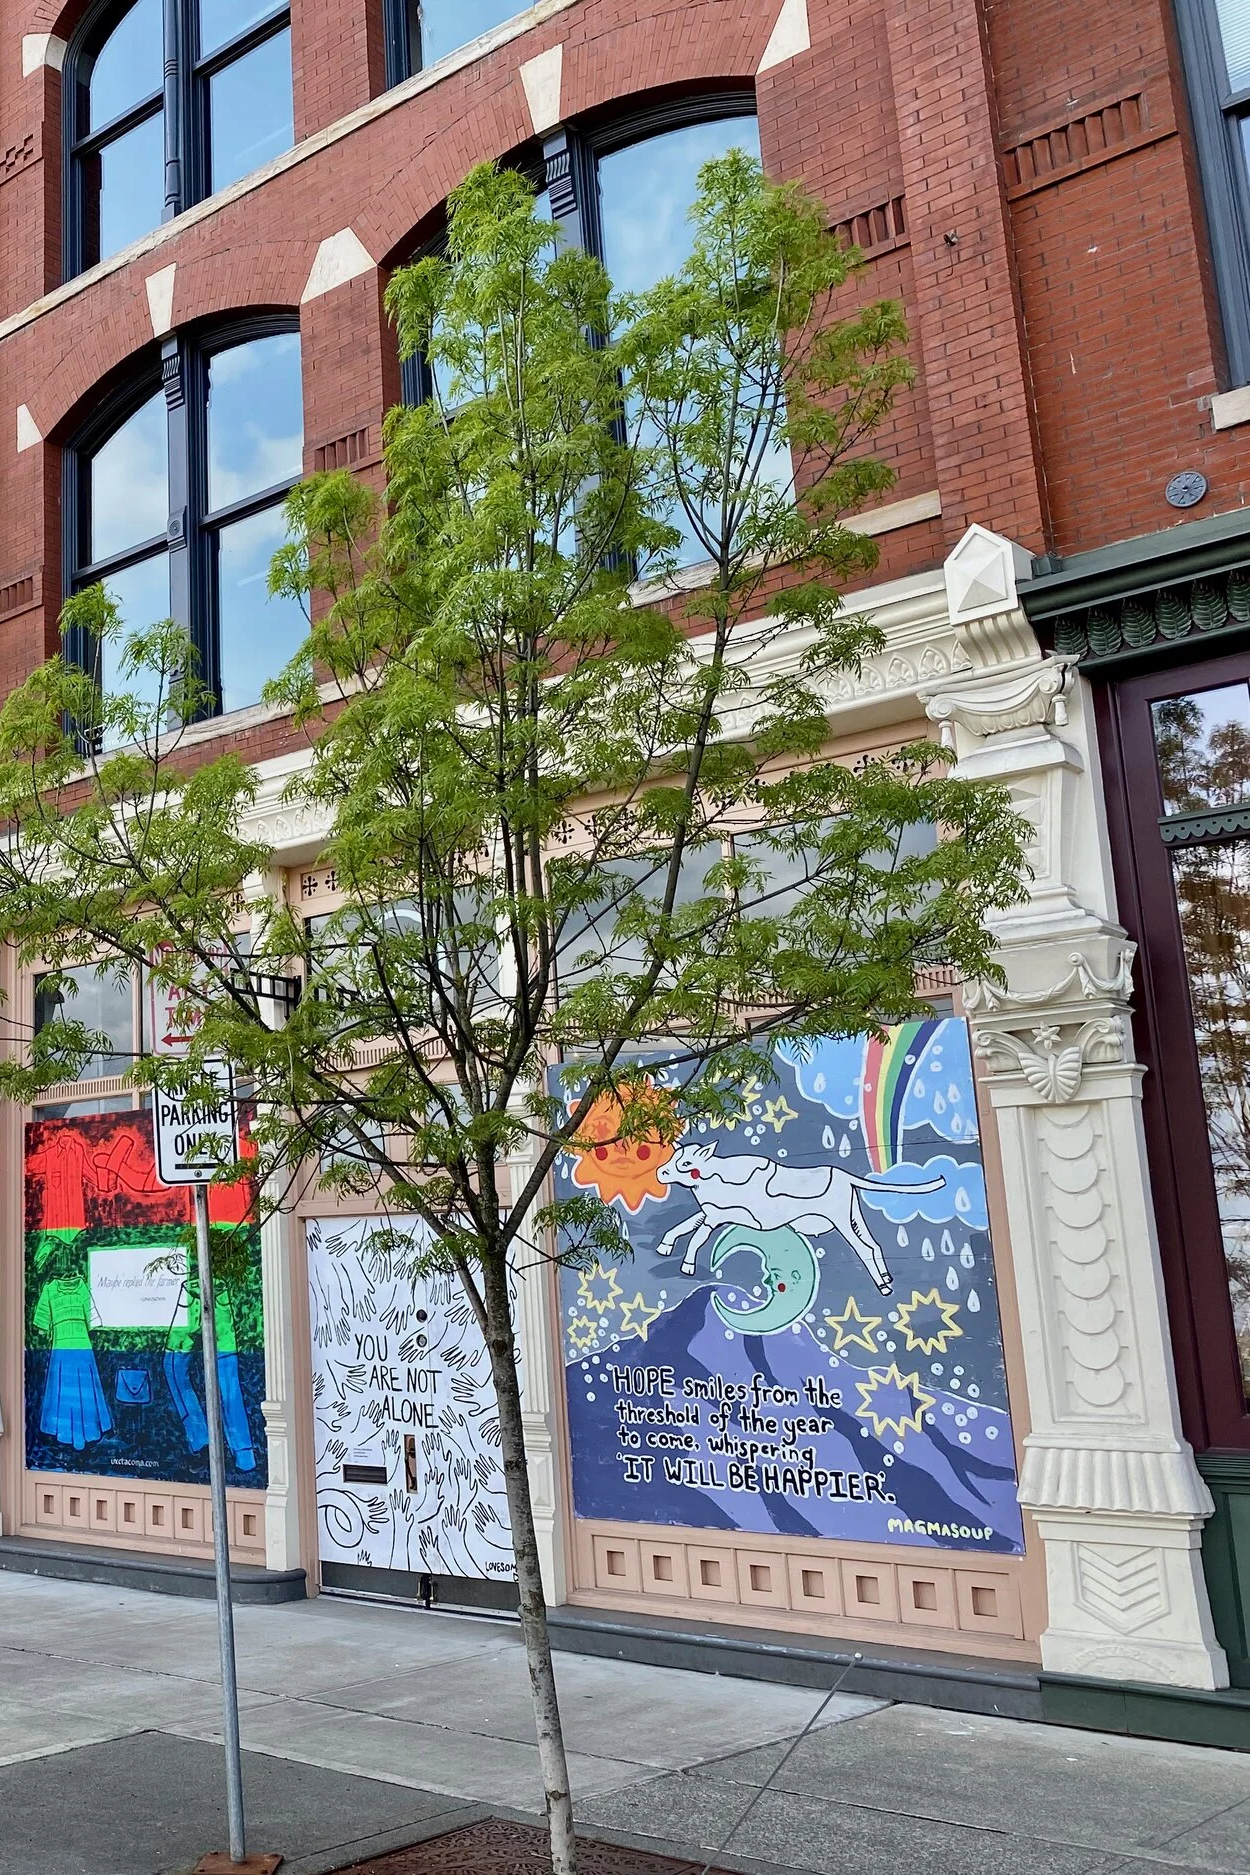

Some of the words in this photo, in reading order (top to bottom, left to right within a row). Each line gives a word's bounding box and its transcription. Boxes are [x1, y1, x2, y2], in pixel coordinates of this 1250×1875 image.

[161, 1100, 229, 1127] PARKING
[355, 1333, 388, 1362] YOU
[369, 1365, 402, 1392] ARE
[406, 1370, 442, 1394] NOT
[613, 1366, 675, 1396] HOPE
[683, 1372, 747, 1400] smiles
[750, 1374, 798, 1409] from
[804, 1376, 842, 1406] the
[383, 1395, 439, 1429] ALONE
[616, 1400, 699, 1424] threshold
[708, 1402, 730, 1432] of
[740, 1405, 777, 1433] the
[783, 1418, 833, 1446] year
[617, 1425, 640, 1446] to
[647, 1433, 700, 1450] come,
[707, 1433, 815, 1470] whispering
[663, 1458, 726, 1489] WILL
[729, 1465, 758, 1493] BE
[887, 1518, 994, 1541] MAGMASOUP
[485, 1561, 518, 1573] LOVESOM
